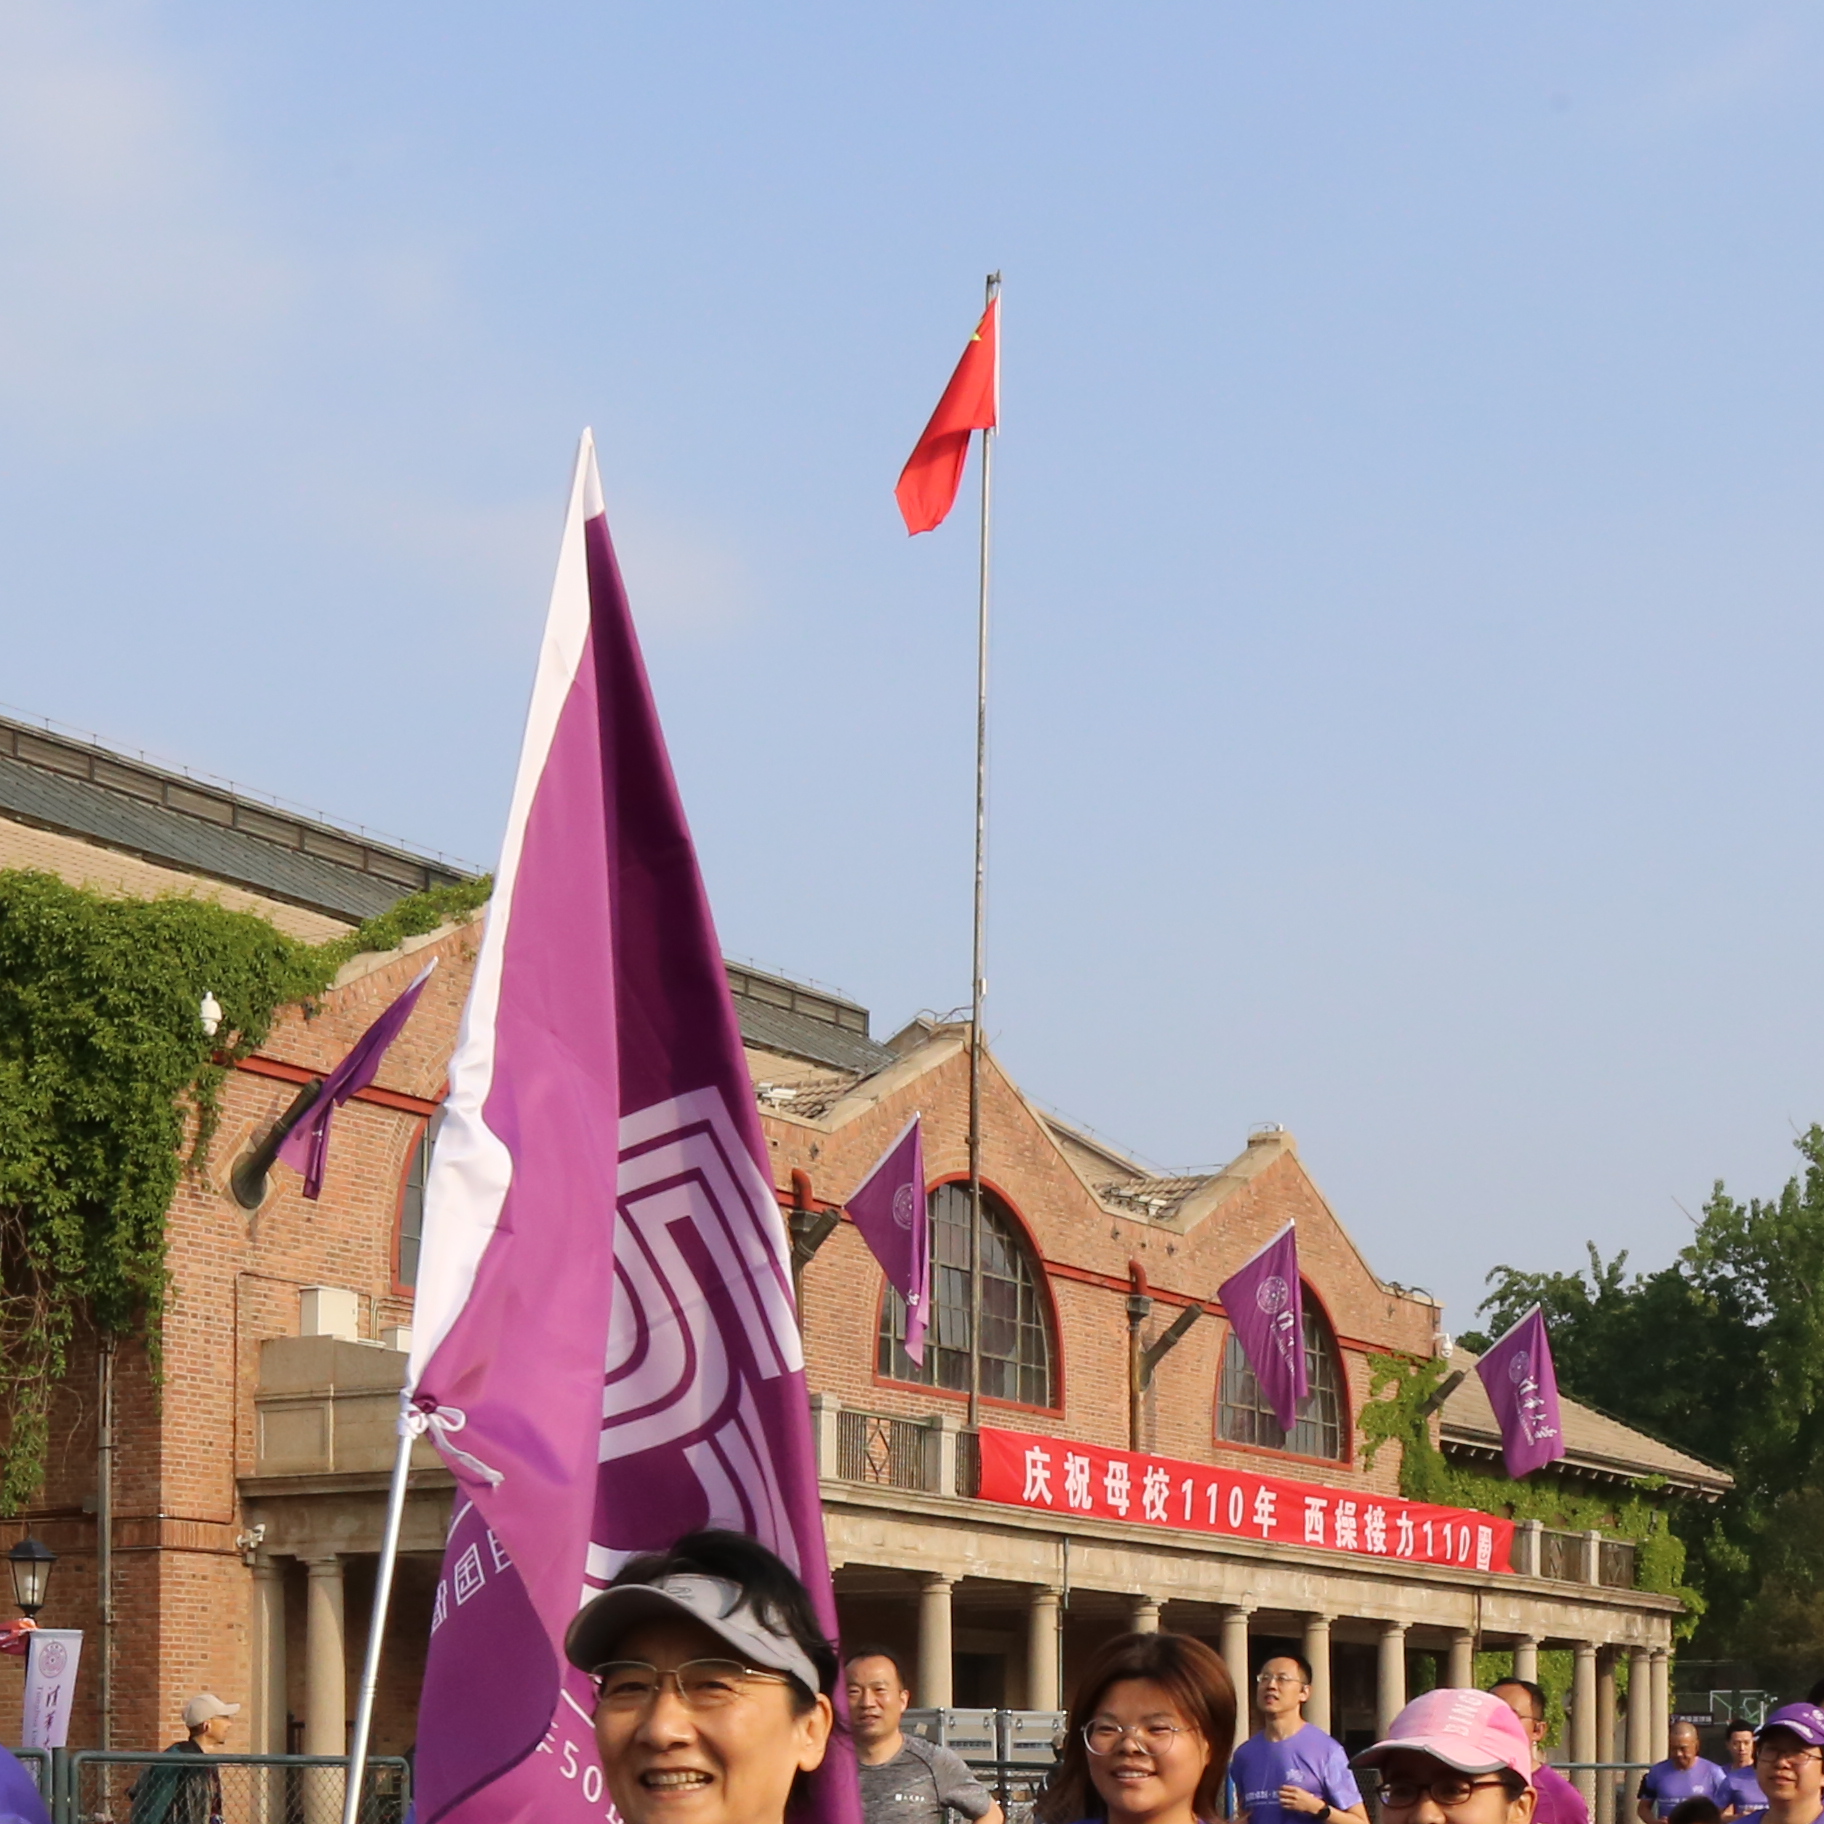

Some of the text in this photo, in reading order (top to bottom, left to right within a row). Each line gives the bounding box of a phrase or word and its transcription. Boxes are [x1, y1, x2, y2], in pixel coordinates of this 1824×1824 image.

[1023, 1445, 1278, 1538] 庆祝母校110年
